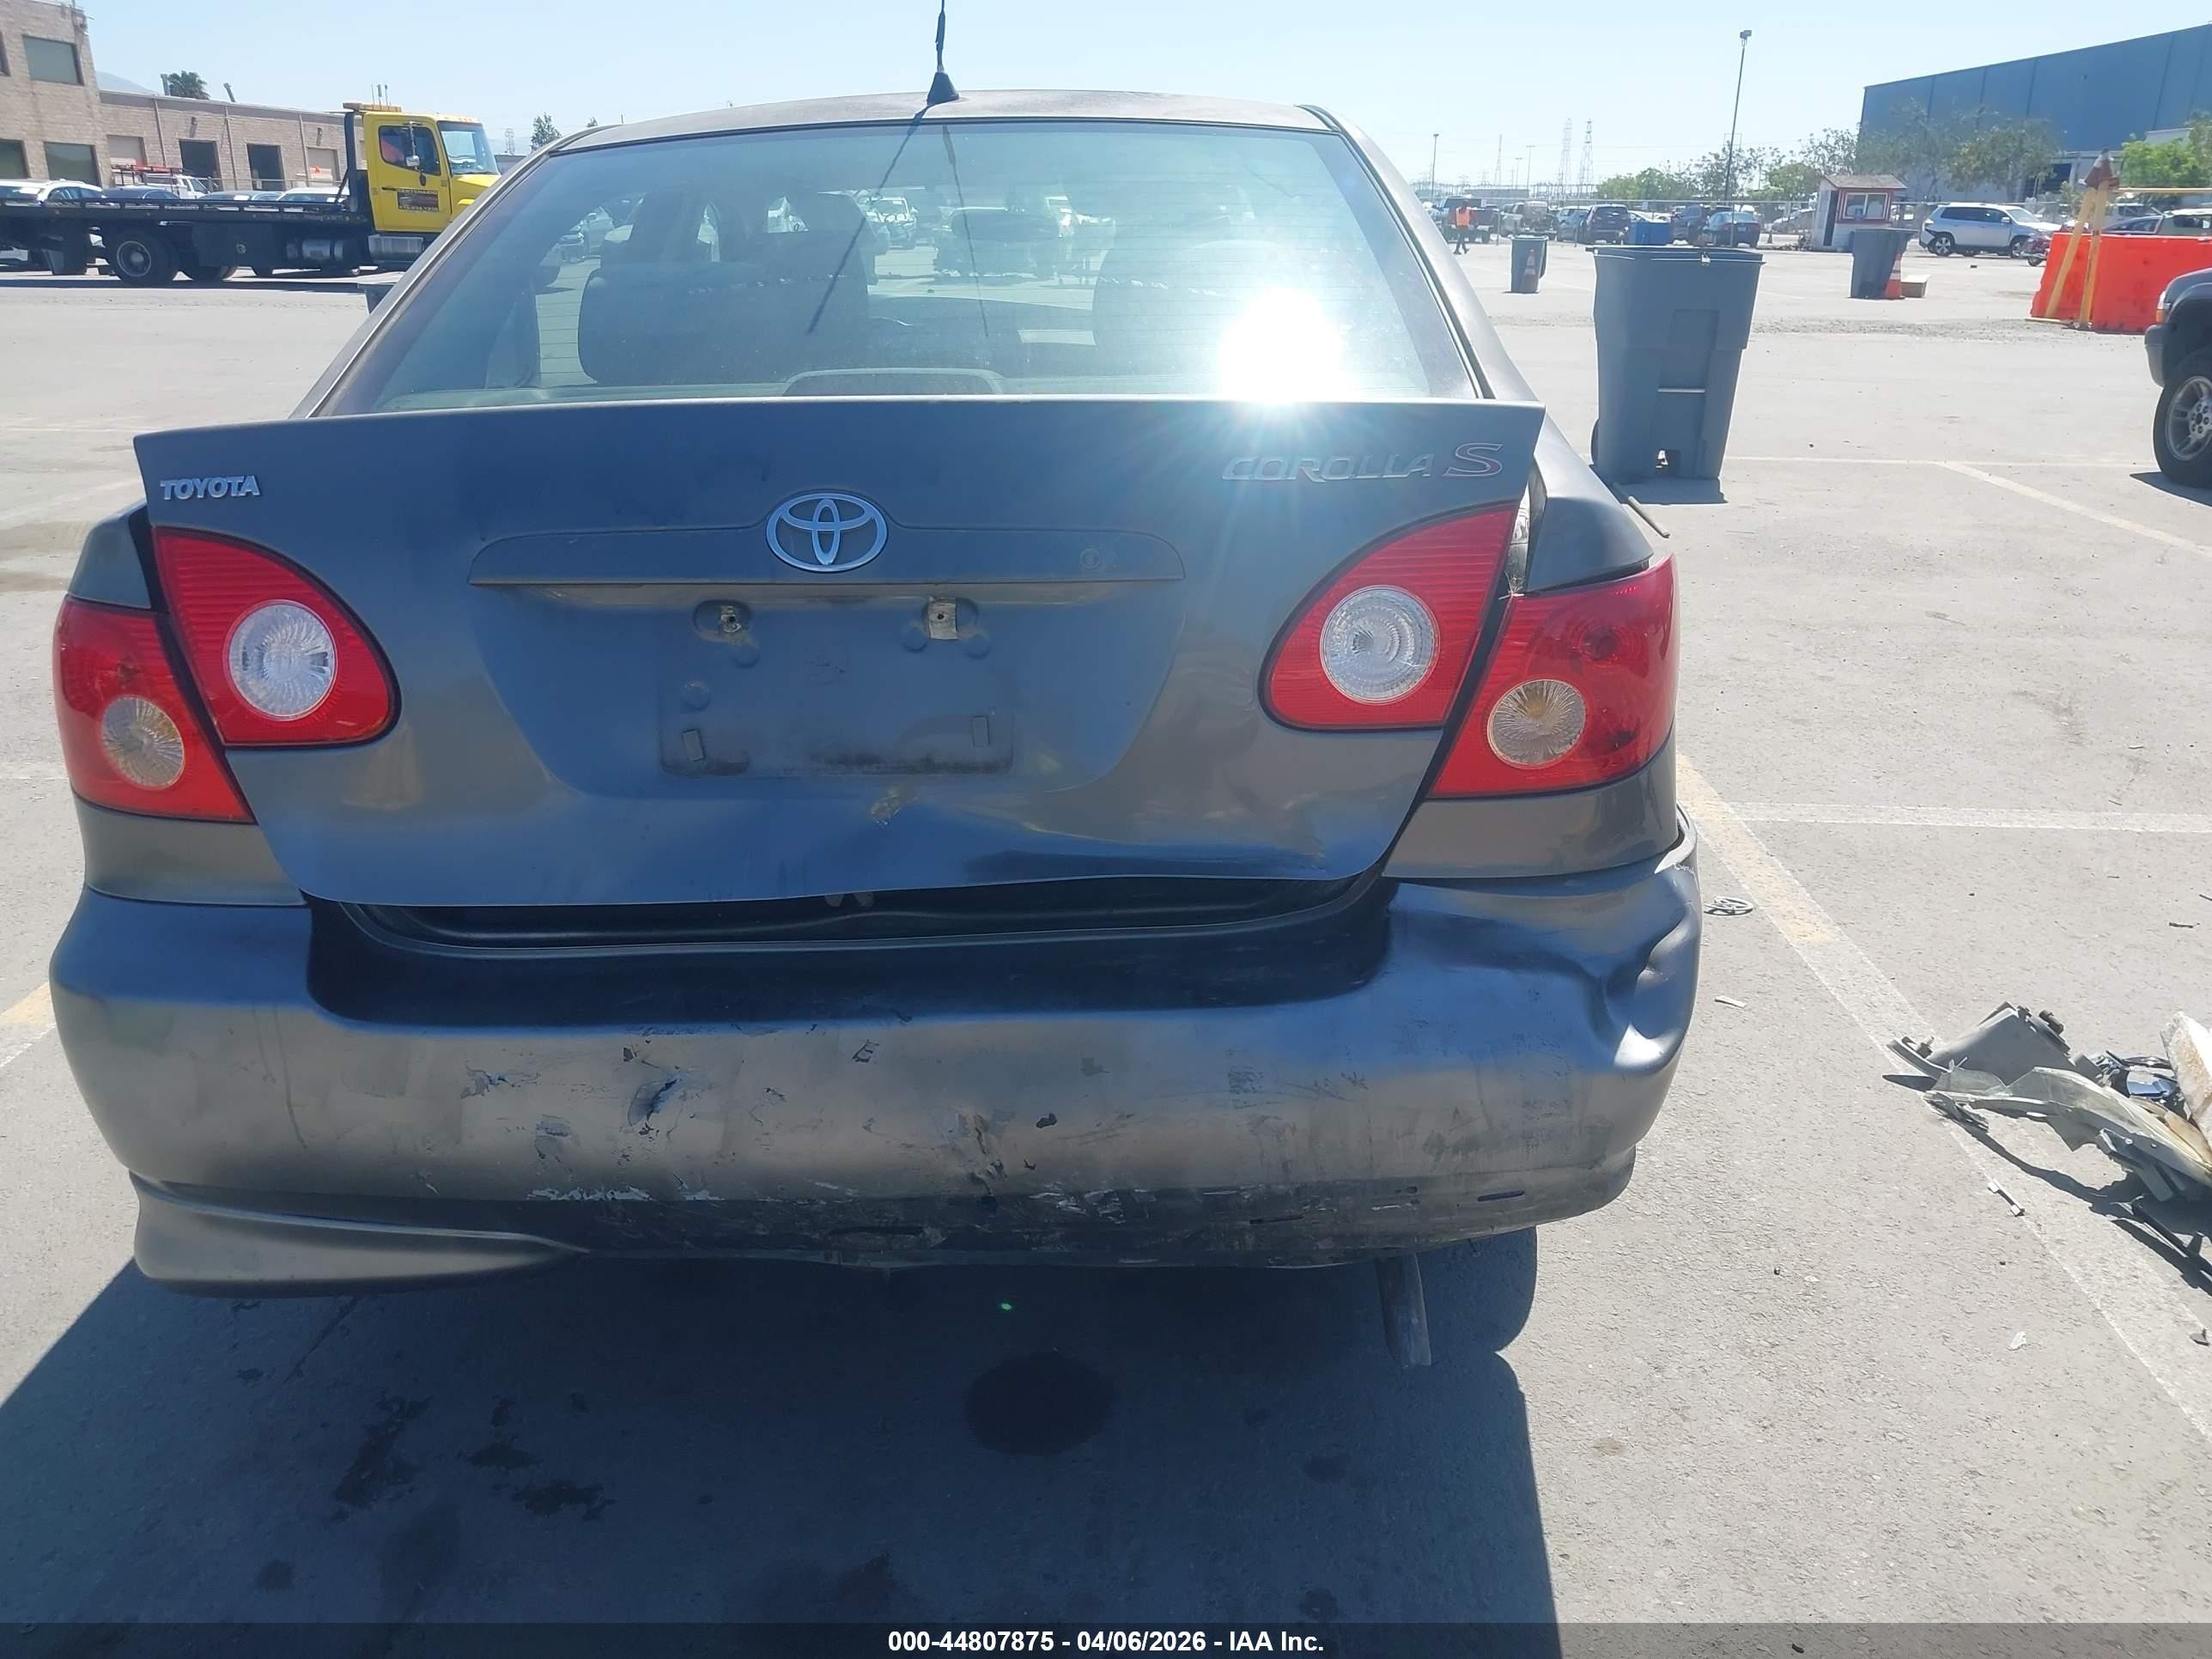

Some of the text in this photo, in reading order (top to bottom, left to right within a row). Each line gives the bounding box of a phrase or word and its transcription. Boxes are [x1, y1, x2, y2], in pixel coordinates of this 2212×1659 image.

[1222, 442, 1504, 483] COROLLA S
[160, 476, 260, 500] TOYOTA
